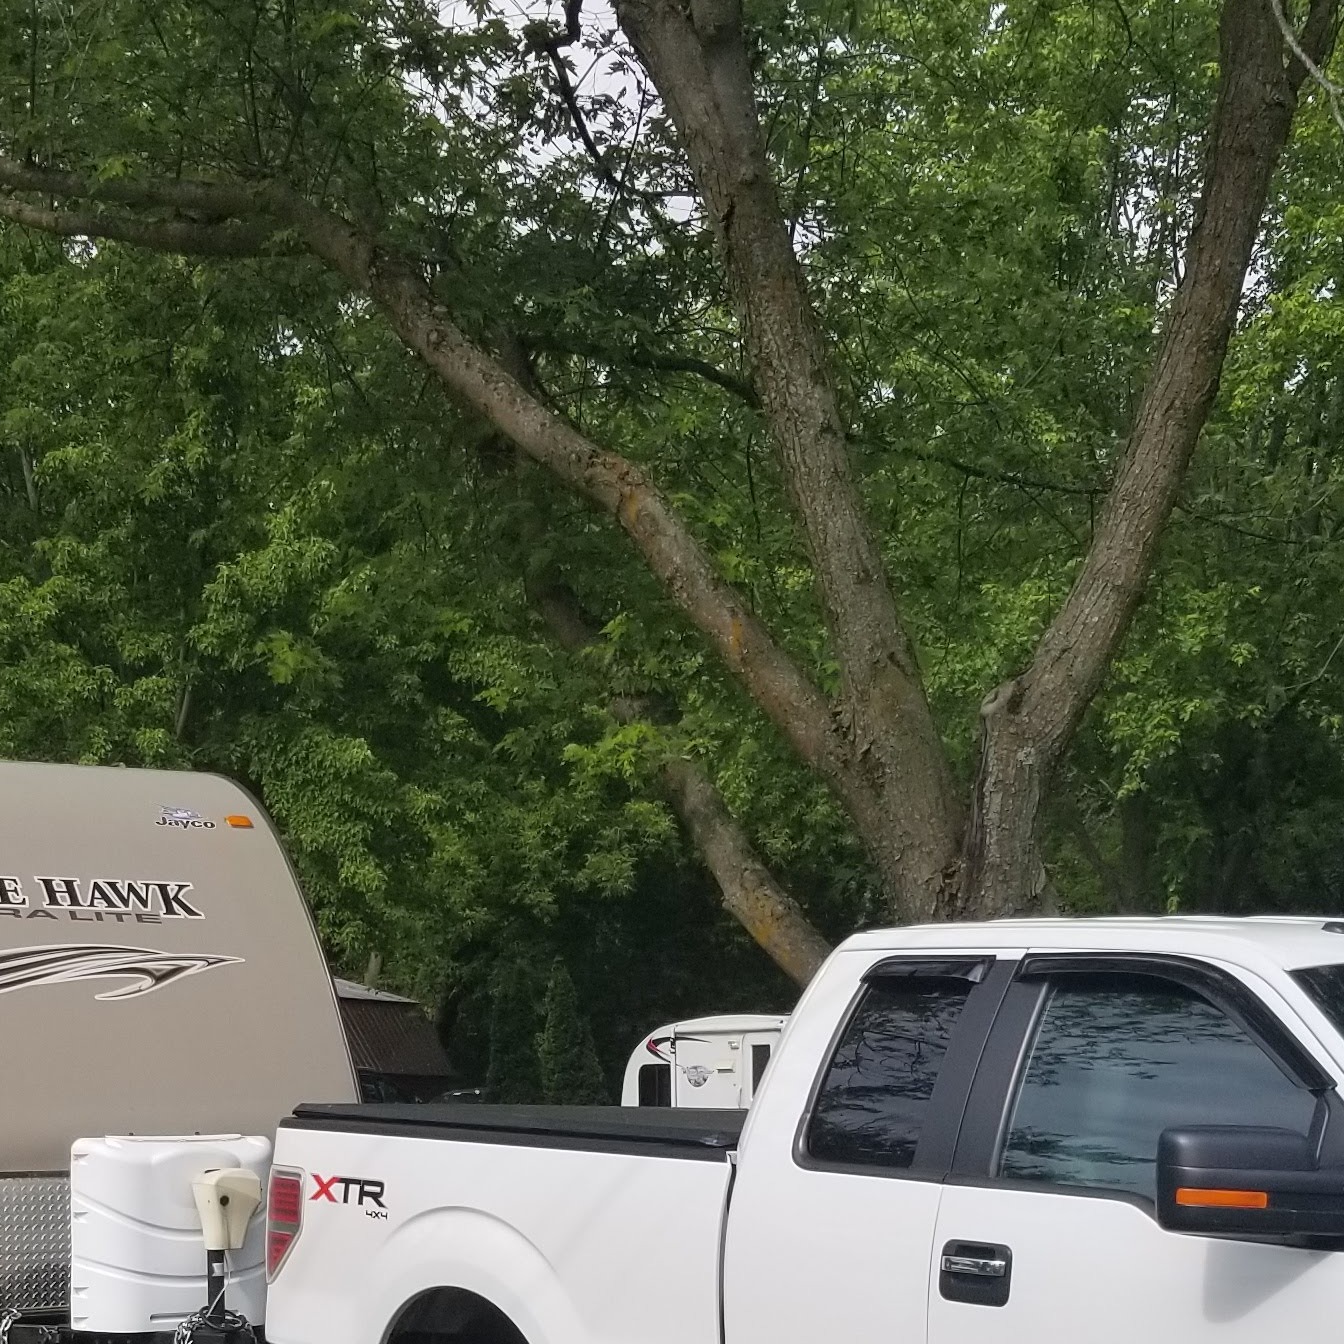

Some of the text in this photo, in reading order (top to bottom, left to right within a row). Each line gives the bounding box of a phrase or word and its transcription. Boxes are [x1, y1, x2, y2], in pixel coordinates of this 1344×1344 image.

[155, 816, 217, 830] Jayco
[33, 875, 205, 919] HAWK
[68, 909, 162, 925] LITE
[309, 1173, 388, 1210] XTR
